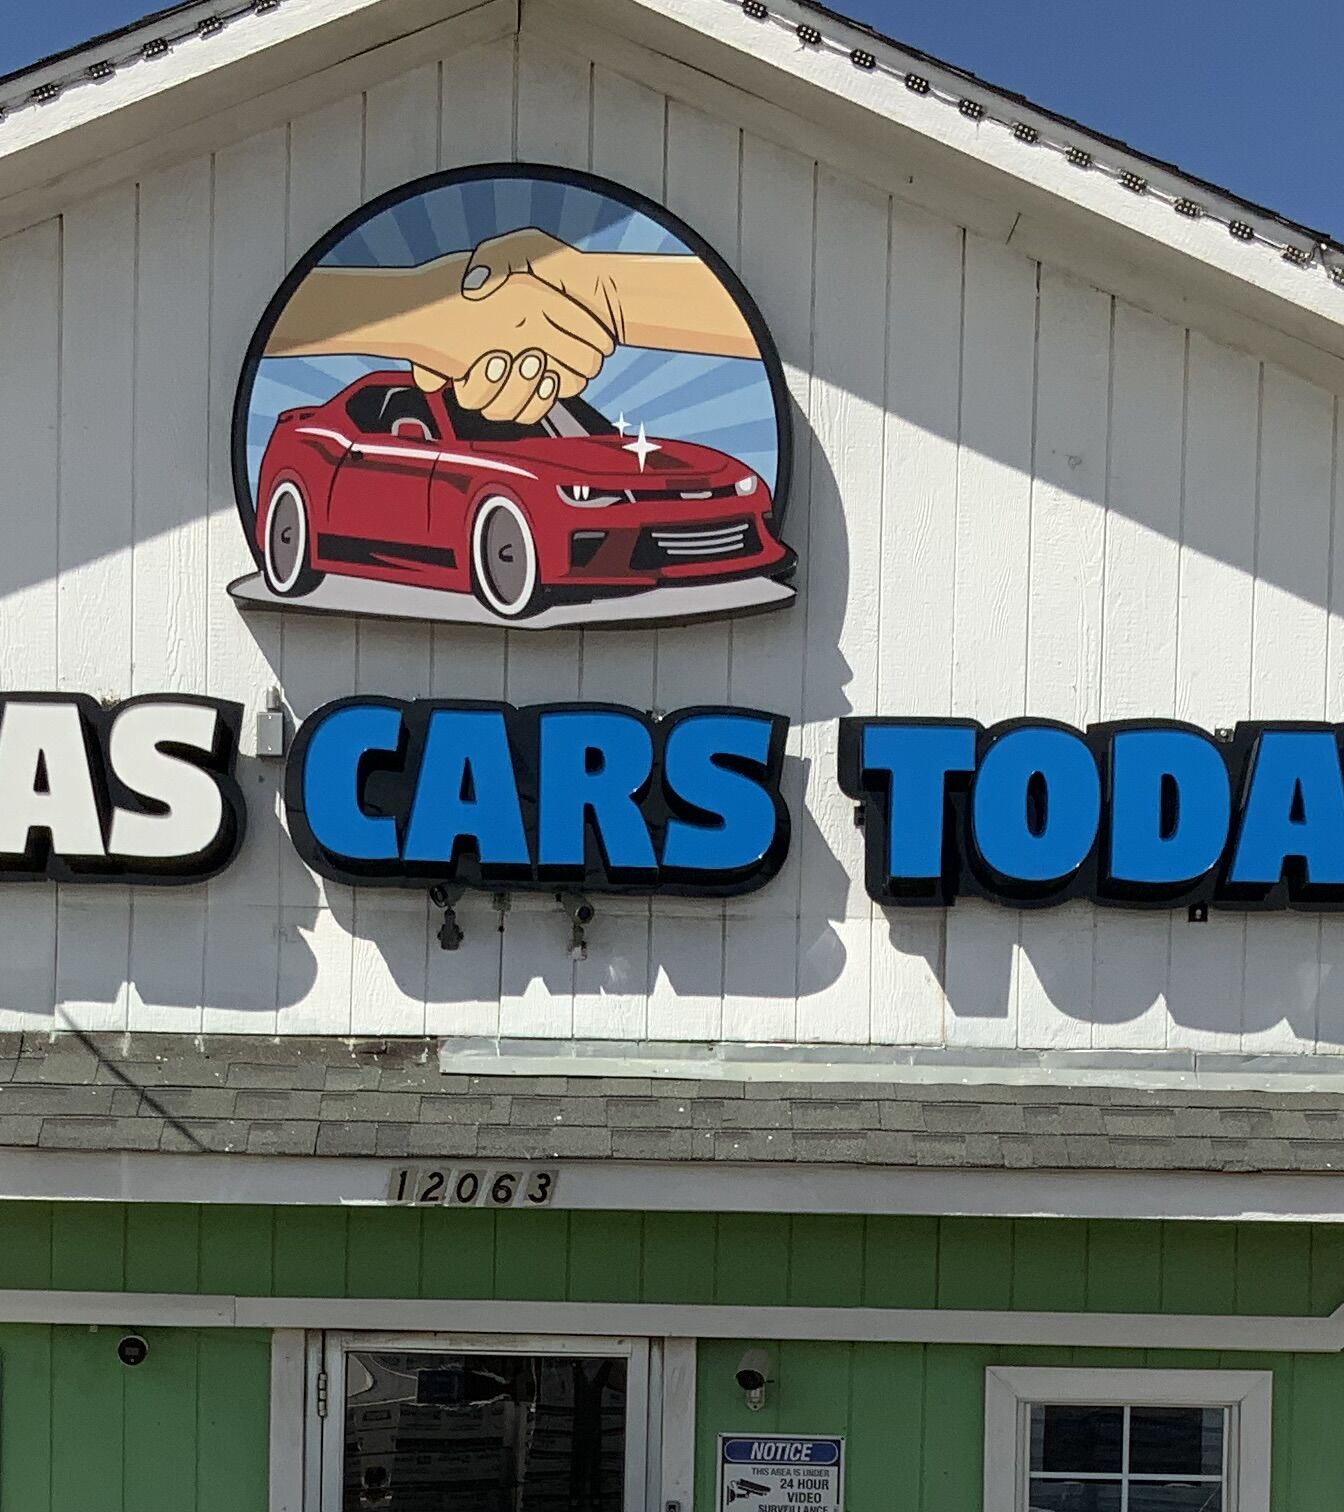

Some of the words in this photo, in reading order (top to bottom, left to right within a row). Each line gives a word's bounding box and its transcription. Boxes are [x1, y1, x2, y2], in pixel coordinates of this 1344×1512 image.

[304, 710, 777, 870] CARS
[397, 1170, 551, 1203] 12063
[750, 1442, 813, 1461] NOTICE
[752, 1467, 769, 1477] THIS
[770, 1468, 791, 1477] AREA
[793, 1468, 800, 1477] IS
[802, 1469, 830, 1478] UNDER
[780, 1478, 794, 1490] 24
[797, 1479, 829, 1491] HOUR
[787, 1491, 822, 1504] VIDEO
